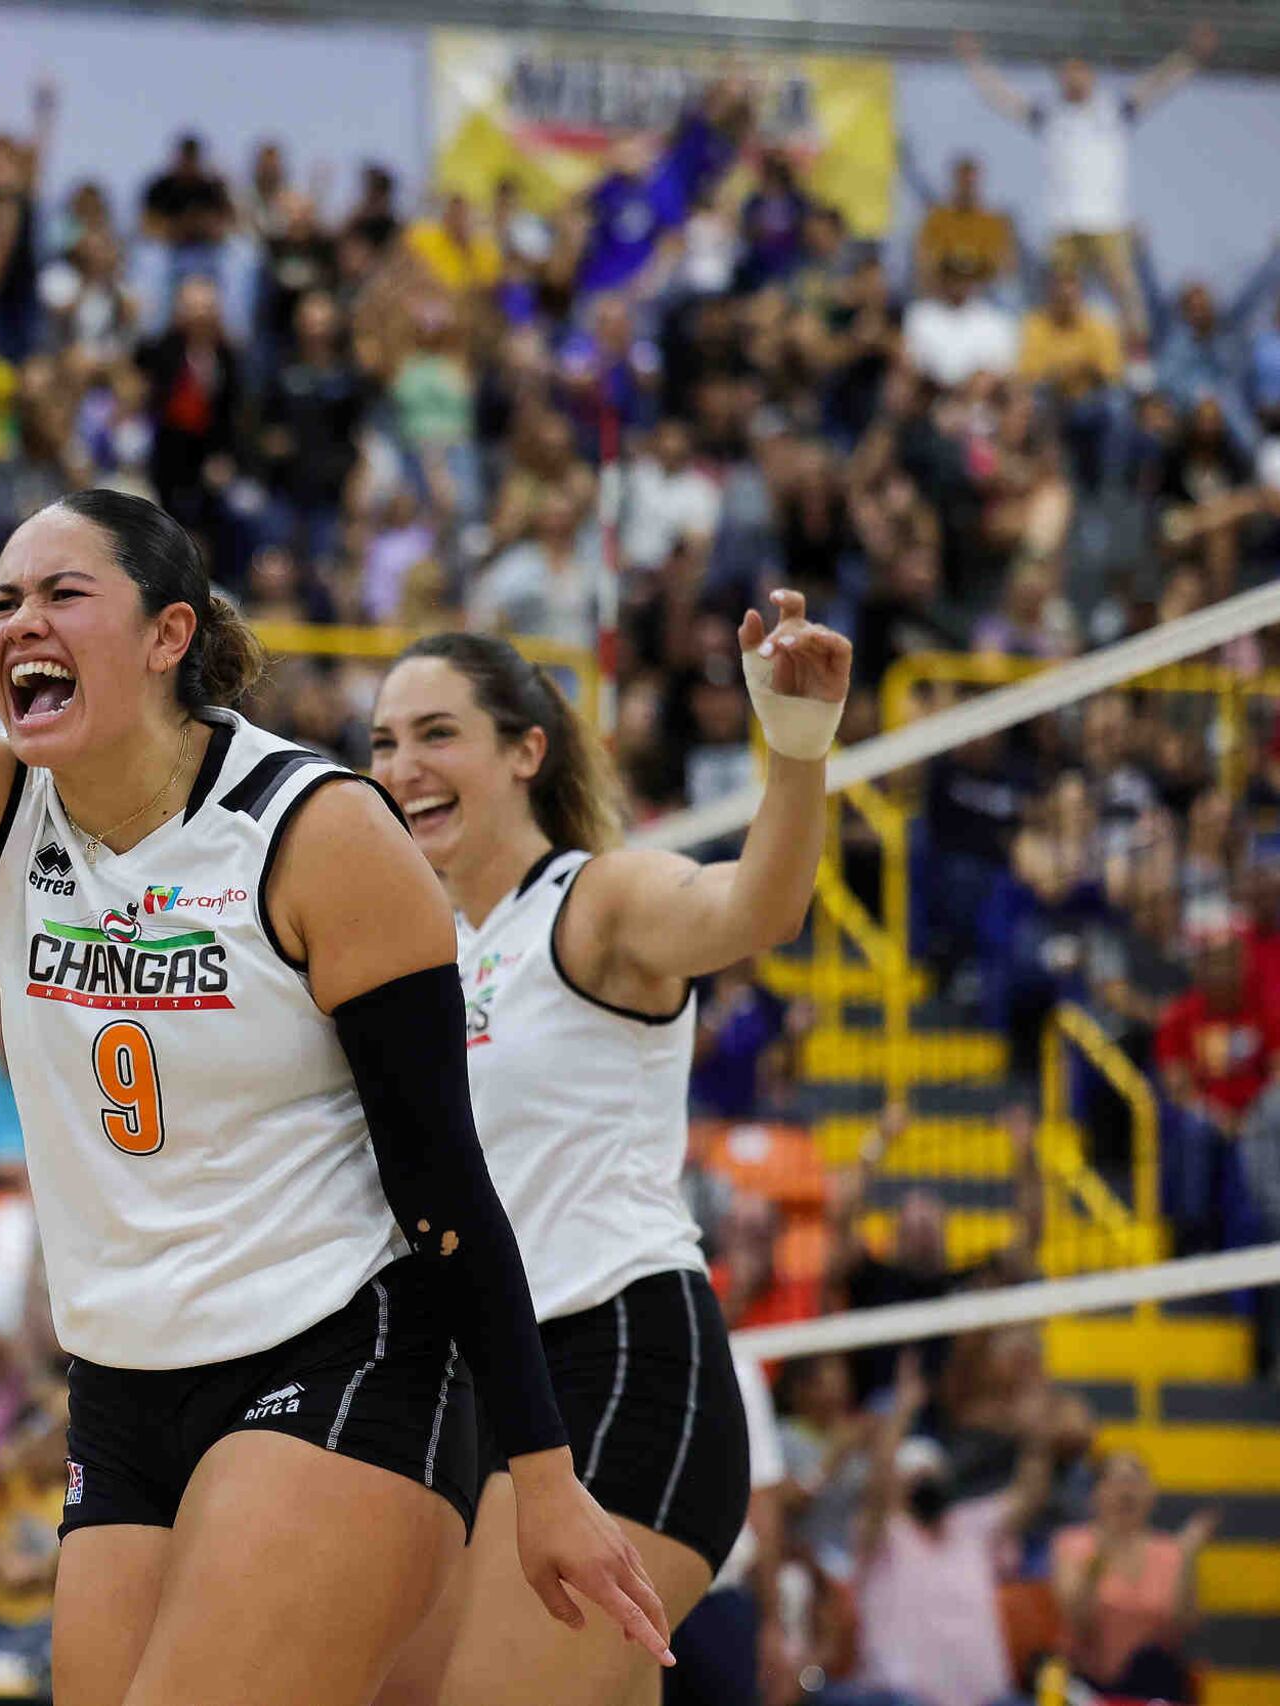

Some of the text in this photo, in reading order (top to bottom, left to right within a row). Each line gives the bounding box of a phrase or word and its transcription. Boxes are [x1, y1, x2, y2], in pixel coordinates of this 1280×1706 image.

[28, 870, 76, 897] errea
[144, 885, 247, 915] Naranjito
[28, 933, 229, 995] CHANGAS
[45, 988, 202, 1009] NARANJITO
[92, 1019, 165, 1156] 9
[244, 1399, 300, 1420] errea
